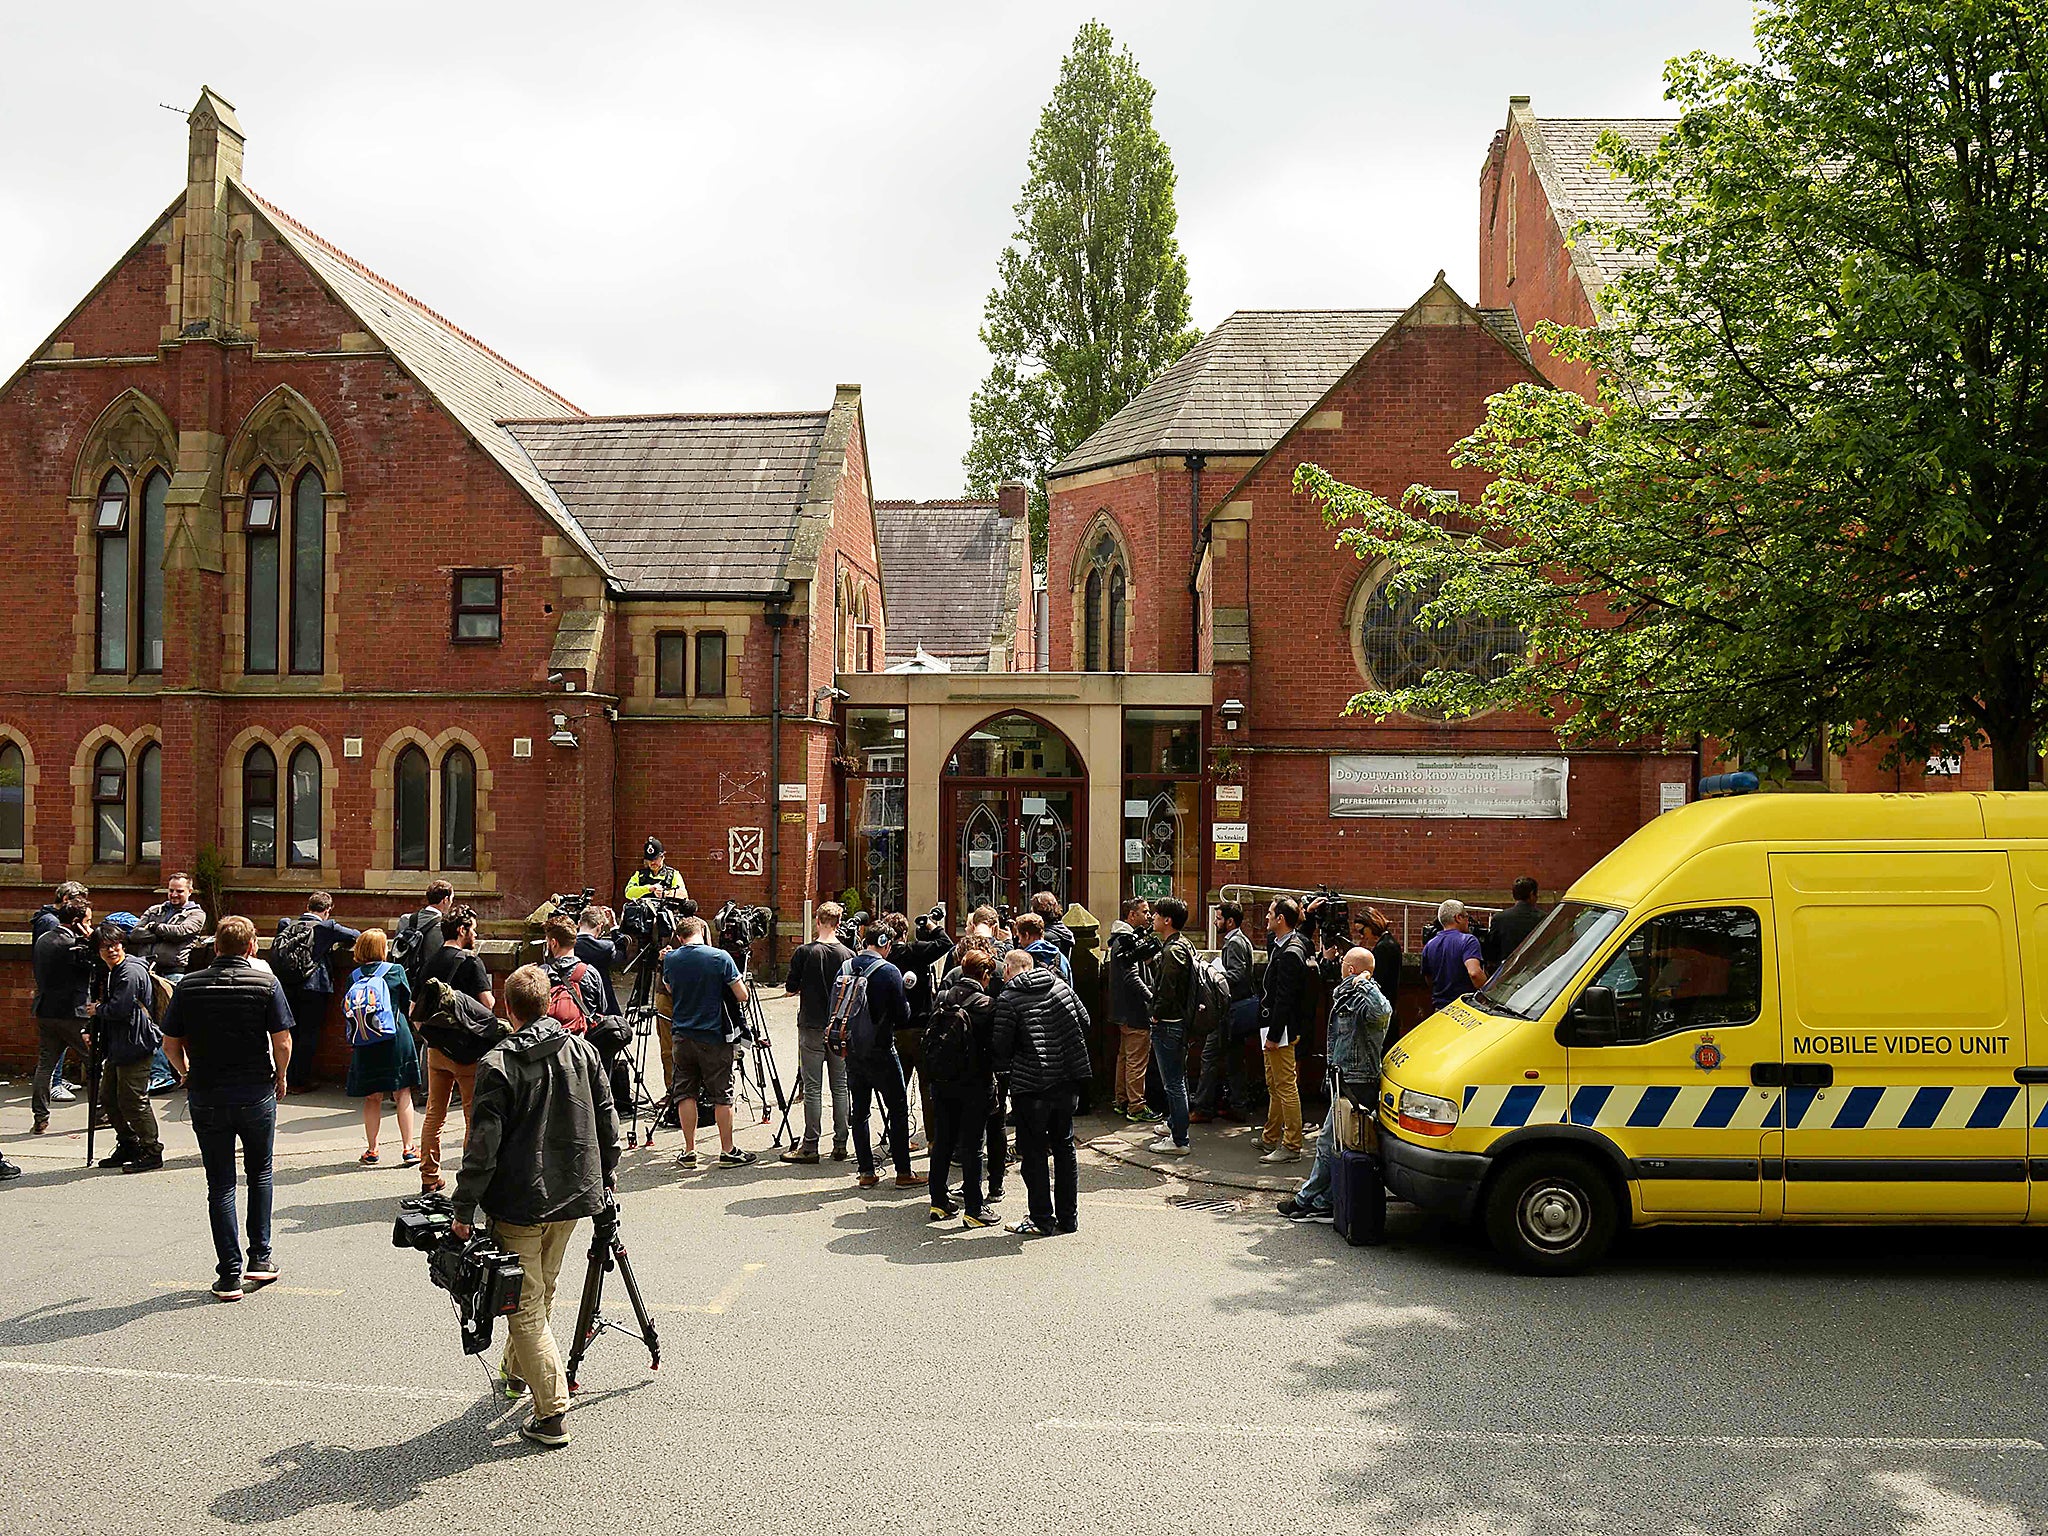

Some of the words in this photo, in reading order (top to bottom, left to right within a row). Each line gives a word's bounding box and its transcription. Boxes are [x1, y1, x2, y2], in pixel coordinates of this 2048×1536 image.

[1336, 769, 1353, 780] Do
[1354, 771, 1377, 782] you
[1379, 770, 1409, 780] want
[1410, 770, 1423, 780] to
[1425, 769, 1458, 780] know
[1460, 769, 1496, 780] about
[1372, 784, 1381, 793] A
[1382, 784, 1426, 793] chance
[1429, 784, 1441, 793] to
[1442, 784, 1497, 793] socialise
[1793, 1036, 1878, 1054] MOBILE
[1883, 1036, 1952, 1054] VIDEO
[1959, 1036, 2010, 1054] UNIT
